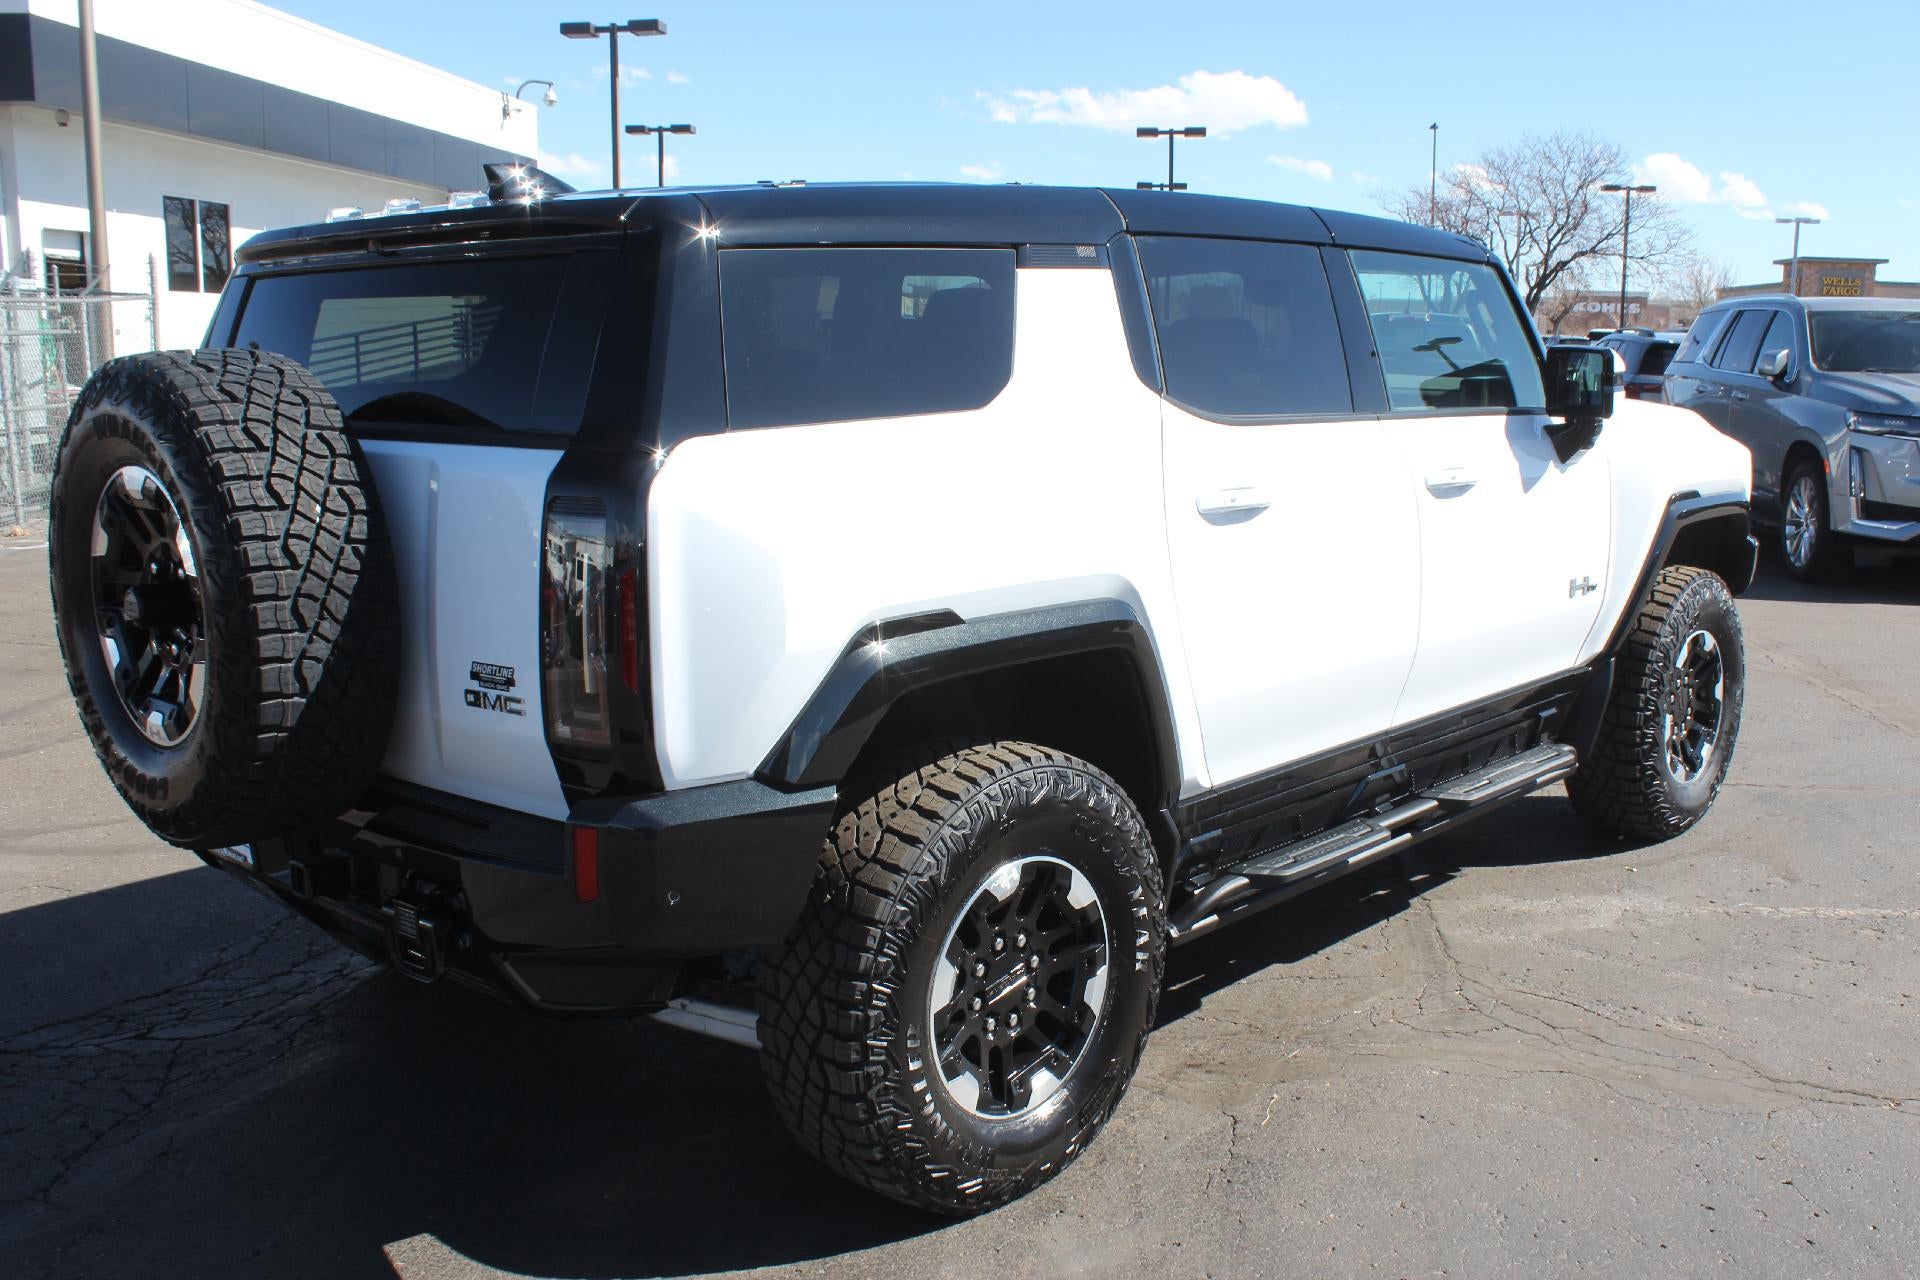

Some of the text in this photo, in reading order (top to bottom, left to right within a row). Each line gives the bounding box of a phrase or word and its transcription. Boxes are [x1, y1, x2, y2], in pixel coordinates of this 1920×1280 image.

[1823, 277, 1861, 286] WELLS
[1823, 286, 1860, 296] FARGO
[472, 663, 513, 678] SHORTLINE
[464, 688, 526, 716] GMC
